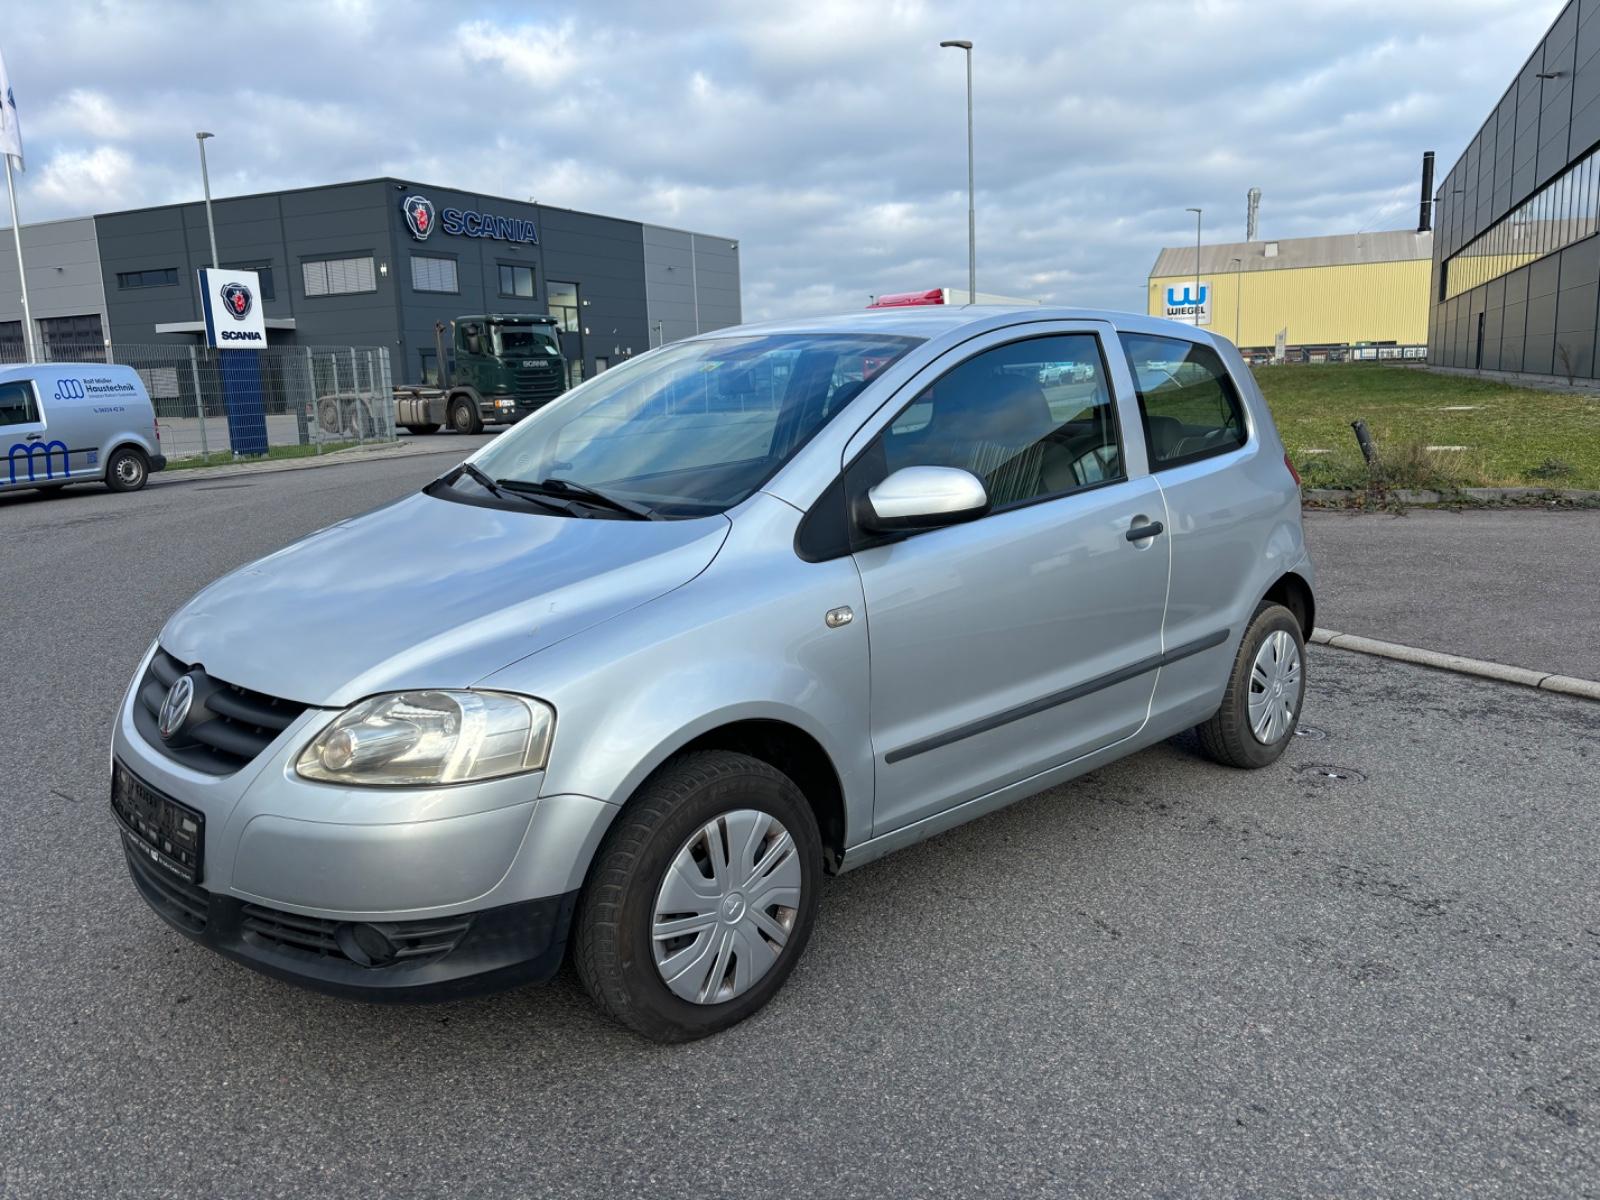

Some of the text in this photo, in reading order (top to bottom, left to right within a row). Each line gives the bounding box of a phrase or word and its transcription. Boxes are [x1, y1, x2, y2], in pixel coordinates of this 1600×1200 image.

[442, 207, 539, 244] SCANIA
[1167, 306, 1205, 315] WIEGEL
[221, 331, 262, 341] SCANIA
[85, 383, 136, 393] Haustechnik
